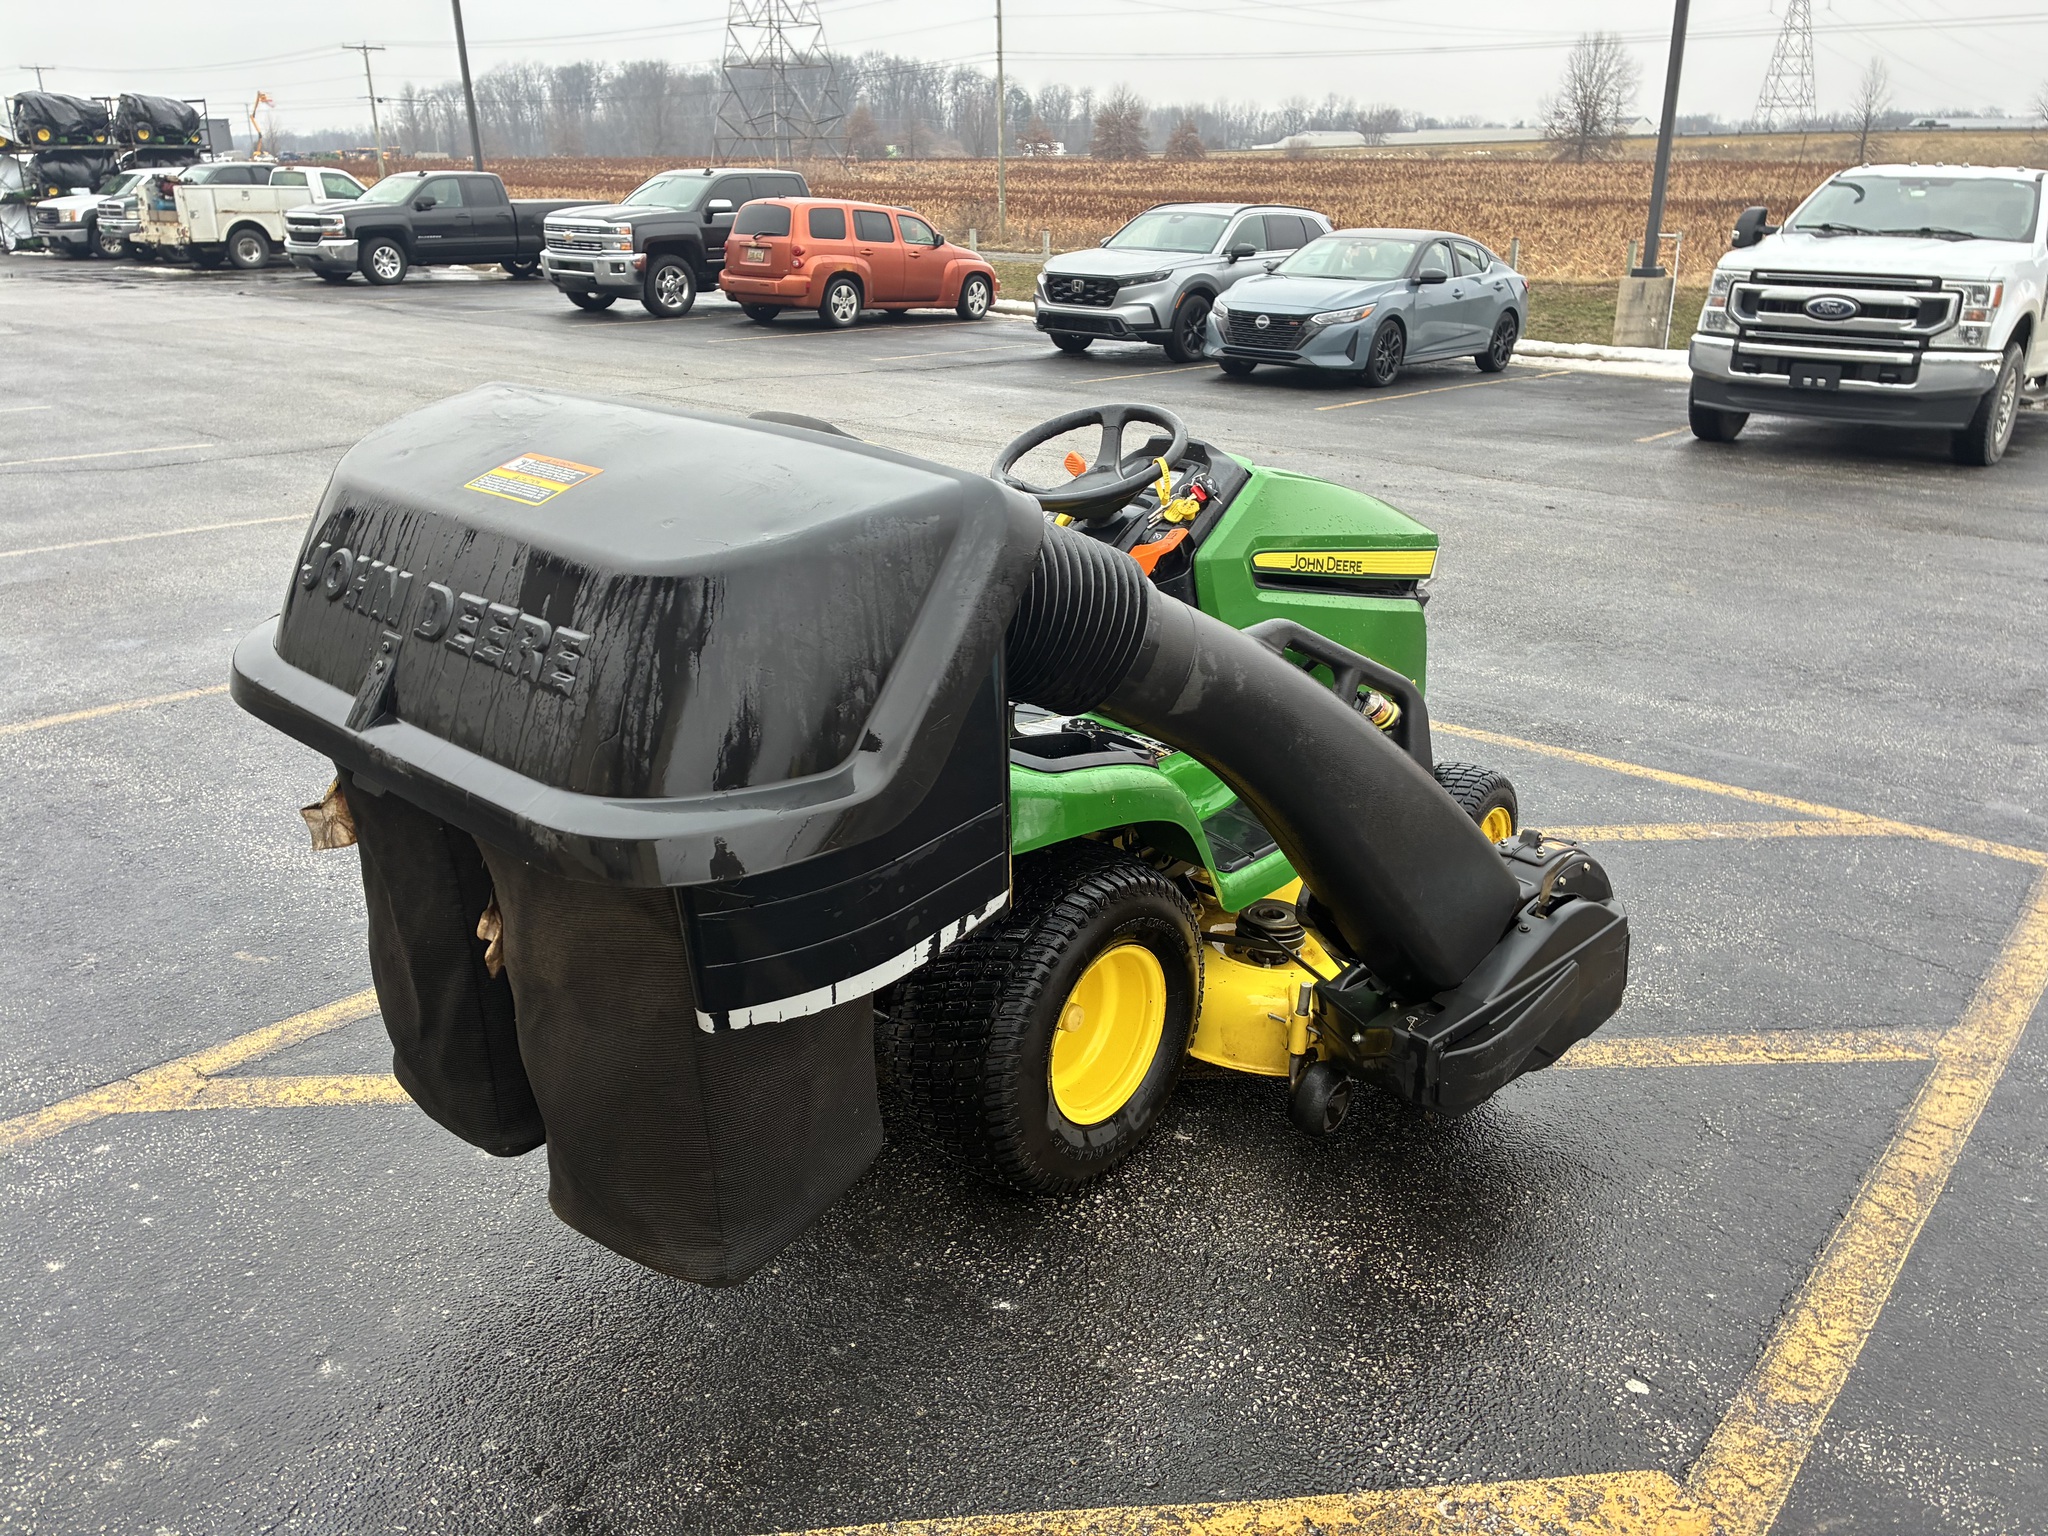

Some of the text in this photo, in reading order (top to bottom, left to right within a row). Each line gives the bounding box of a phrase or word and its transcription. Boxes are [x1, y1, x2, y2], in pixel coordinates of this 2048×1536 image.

[1816, 302, 1844, 314] Ford
[1290, 554, 1363, 573] JOHN DEERE
[301, 541, 590, 697] JOHN DEERE
